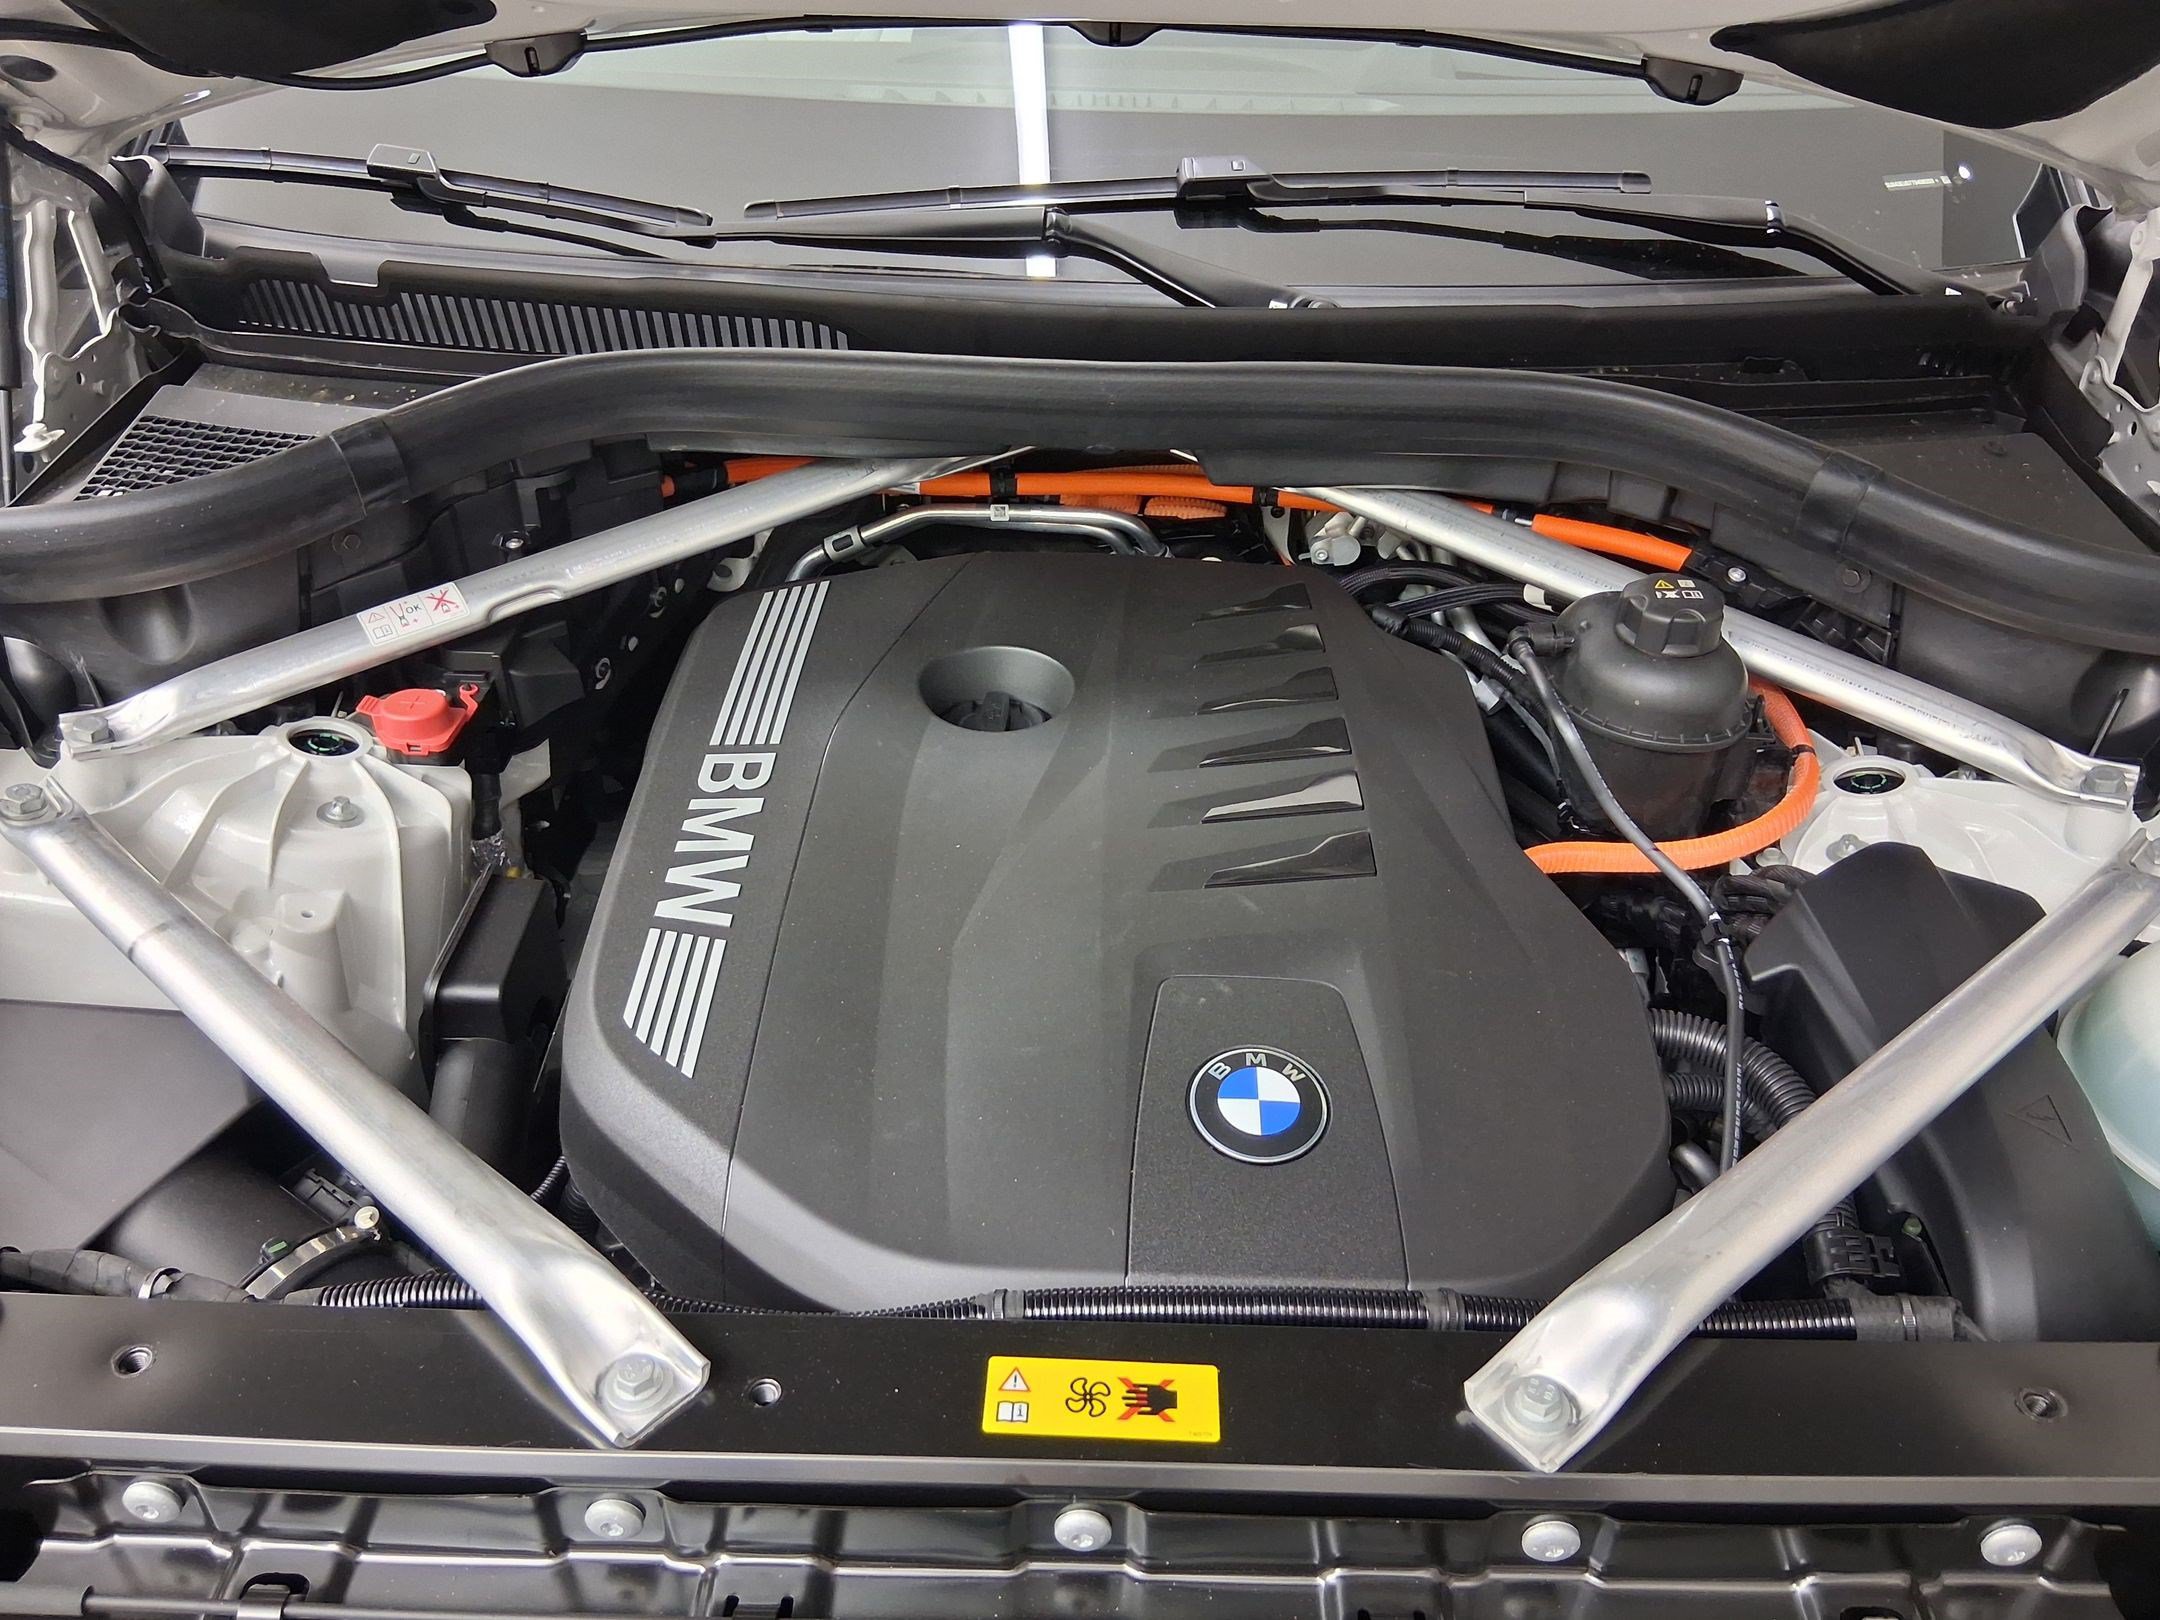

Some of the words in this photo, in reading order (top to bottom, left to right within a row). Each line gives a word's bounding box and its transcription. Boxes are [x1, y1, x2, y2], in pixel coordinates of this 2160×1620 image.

[405, 604, 421, 614] OK
[654, 752, 777, 928] BMW
[1208, 1053, 1306, 1082] BMW
